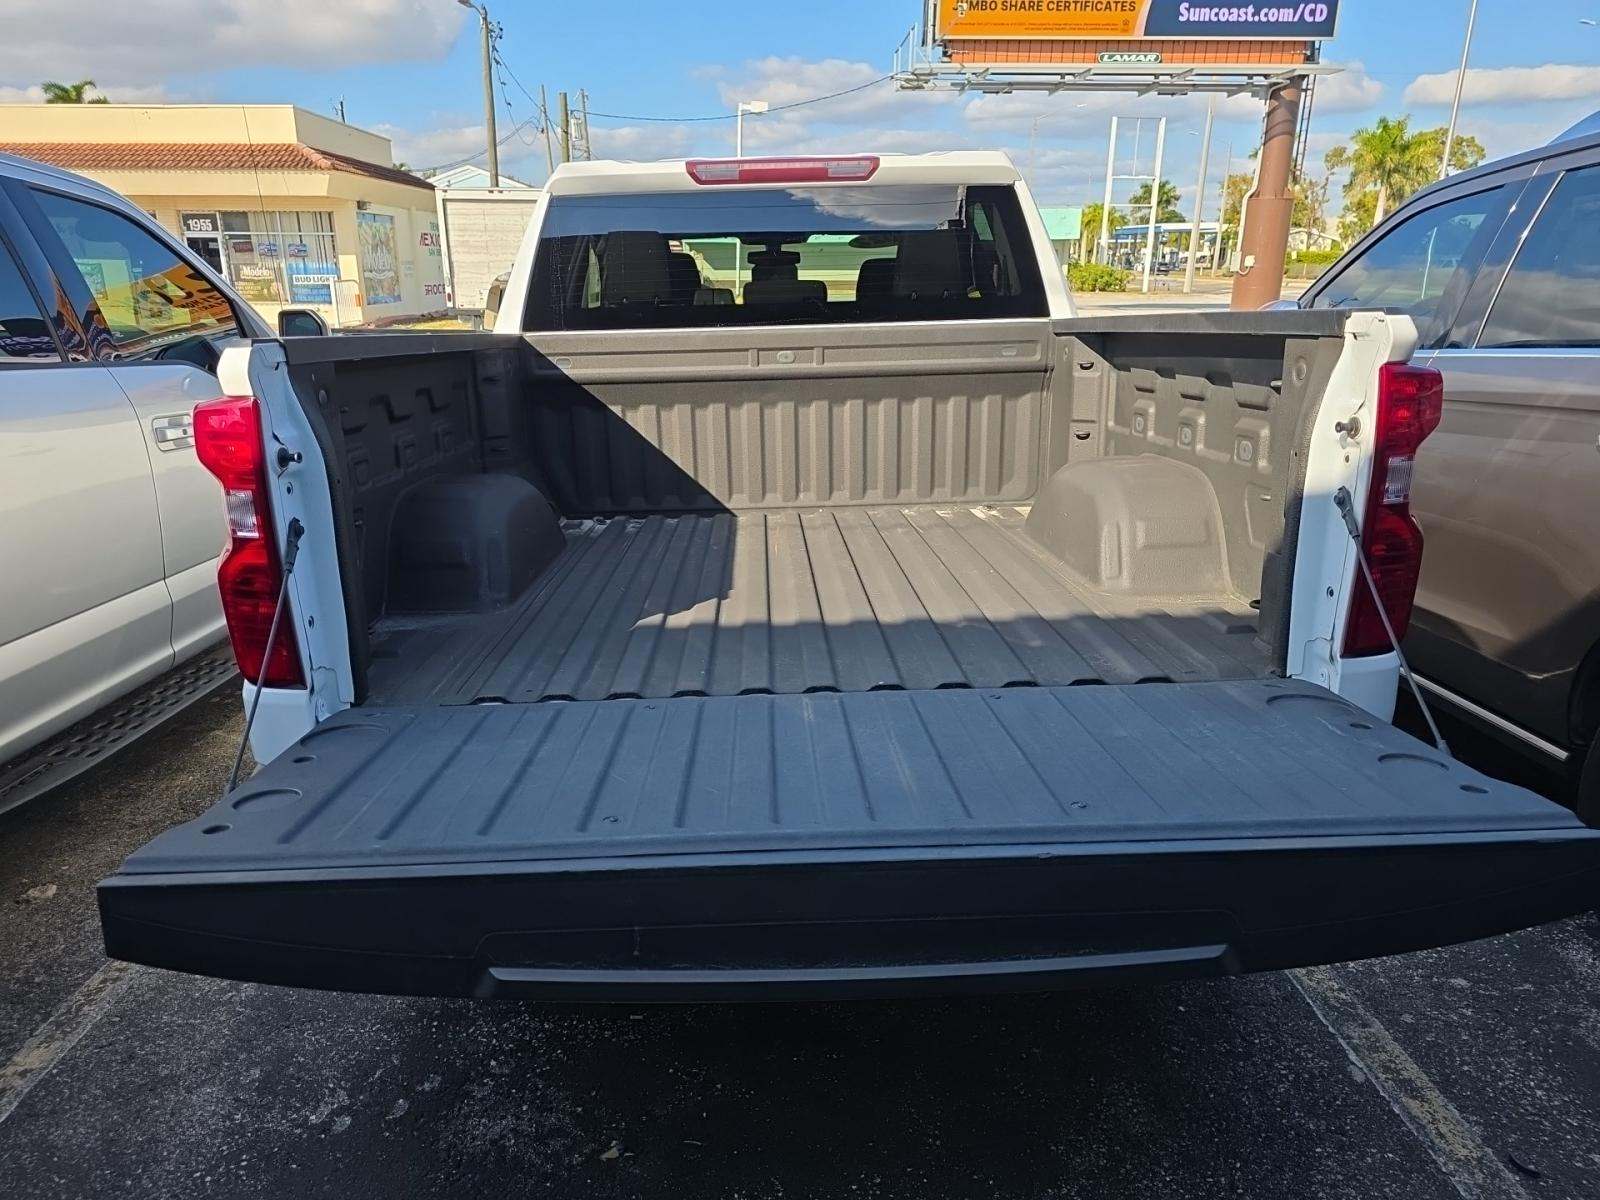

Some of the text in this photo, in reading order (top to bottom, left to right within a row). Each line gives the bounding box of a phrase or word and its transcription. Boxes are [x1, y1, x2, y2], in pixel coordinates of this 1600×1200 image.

[1001, 0, 1044, 11] SHARE
[1046, 0, 1136, 11] CERTIFICATES
[1178, 2, 1328, 23] Suncoast.com/CD
[1102, 53, 1157, 62] LAMAR
[187, 218, 213, 231] 1955
[294, 275, 312, 283] BUD
